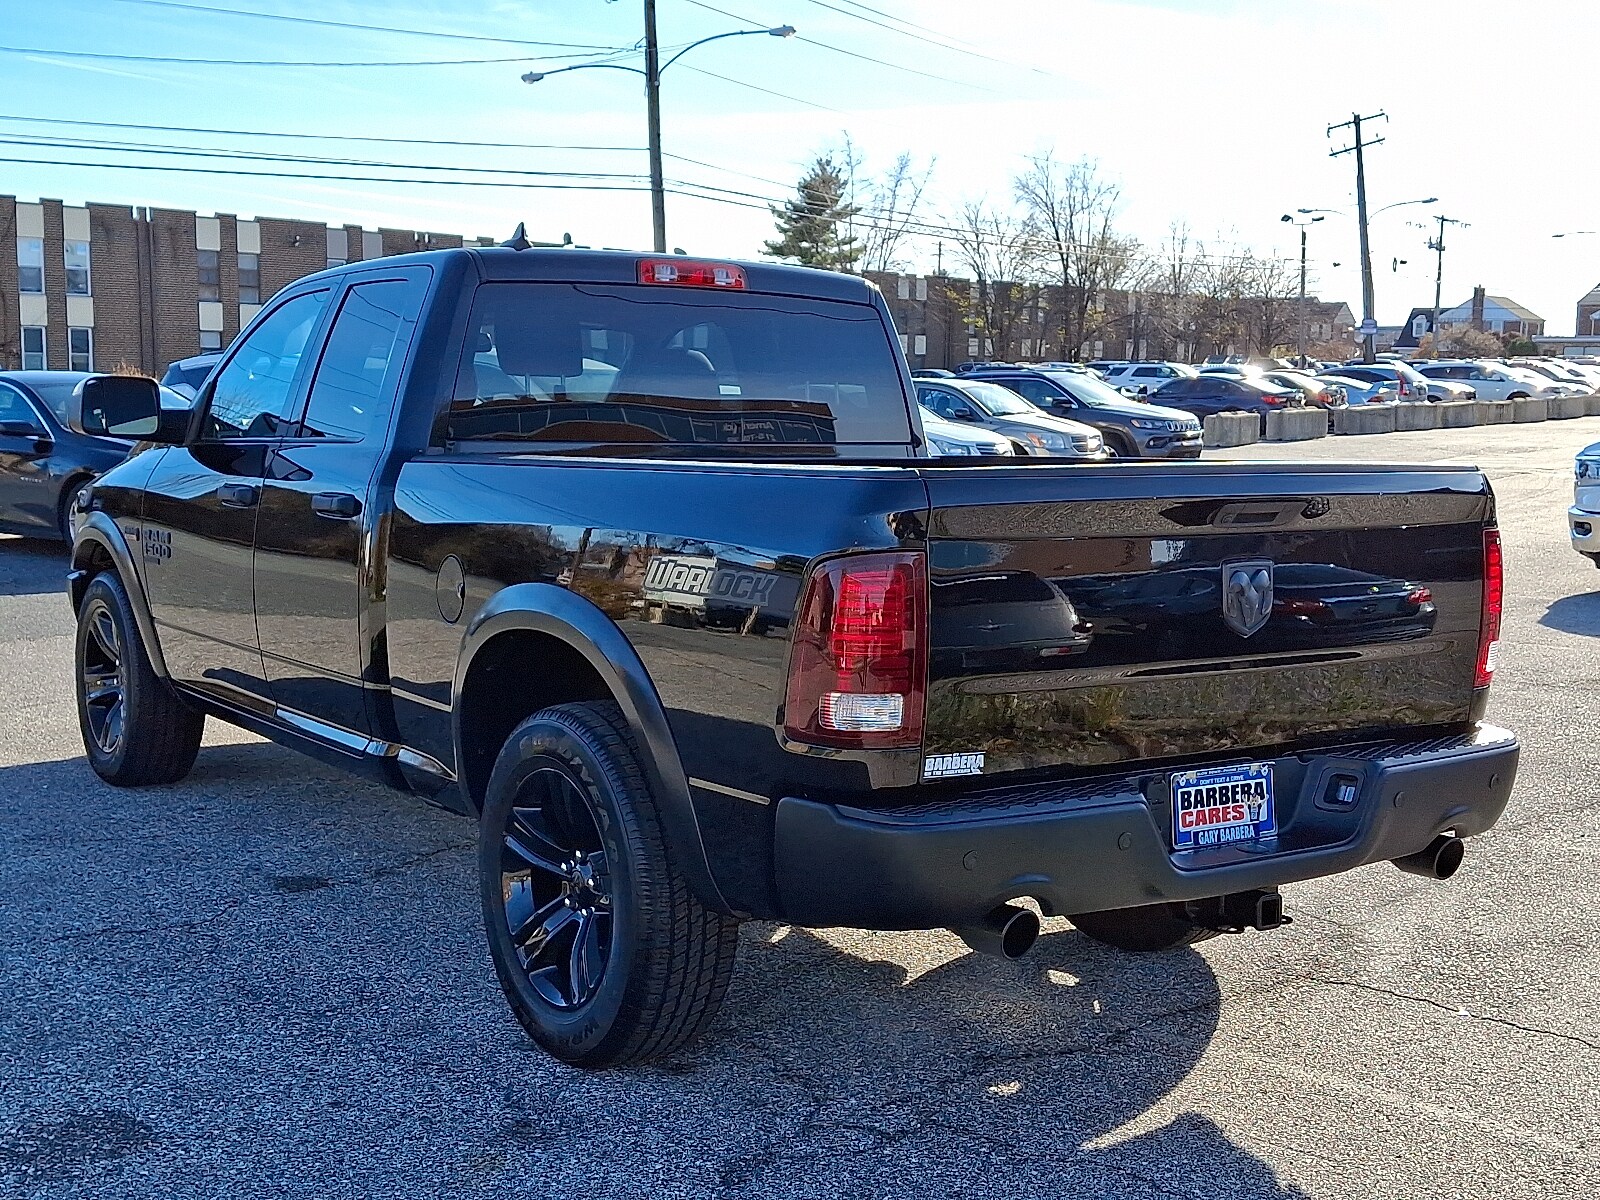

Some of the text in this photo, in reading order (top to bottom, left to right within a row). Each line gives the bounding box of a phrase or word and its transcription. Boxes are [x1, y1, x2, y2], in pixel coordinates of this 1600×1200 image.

[143, 528, 172, 545] RAM
[643, 557, 780, 607] WARLOCK
[924, 754, 985, 771] BARBERA
[1180, 781, 1265, 811] BARBERA
[1181, 804, 1245, 829] CARES
[1198, 825, 1256, 845] GARY BARBERA
